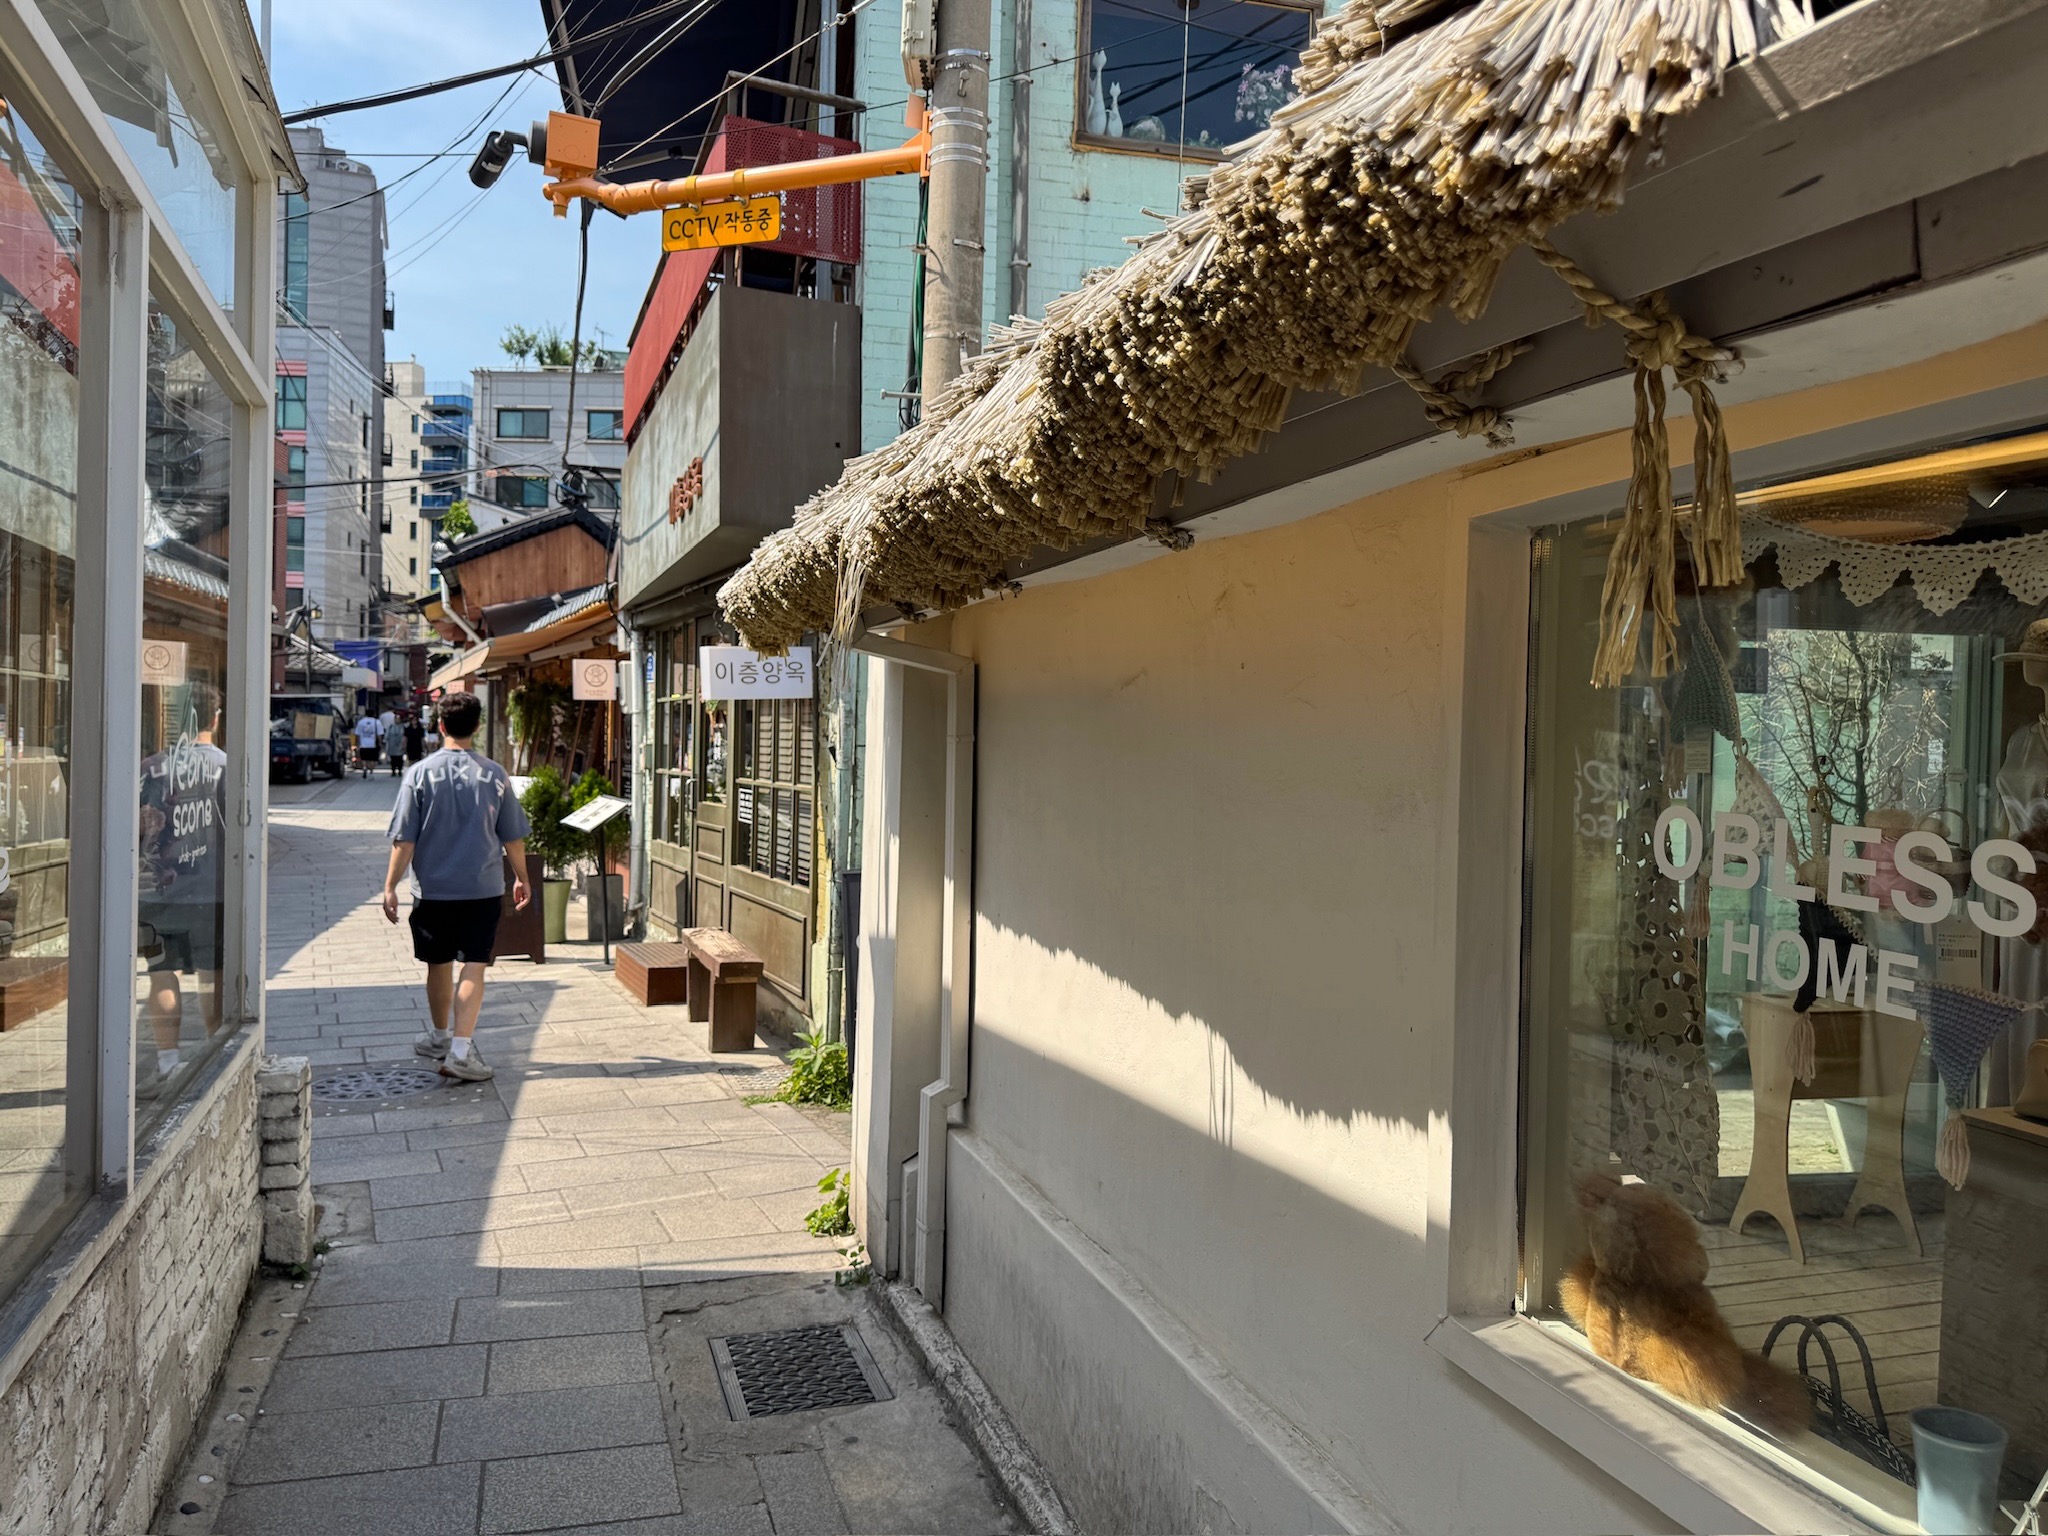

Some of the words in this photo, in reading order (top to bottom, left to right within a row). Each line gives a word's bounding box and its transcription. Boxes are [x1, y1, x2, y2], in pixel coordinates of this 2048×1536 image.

[669, 215, 719, 240] CCTV
[724, 208, 772, 233] 작동중
[715, 661, 806, 685] 이층양옥
[173, 798, 213, 837] scone
[1653, 805, 2037, 938] OBLESS
[1720, 919, 1919, 1021] HOME
